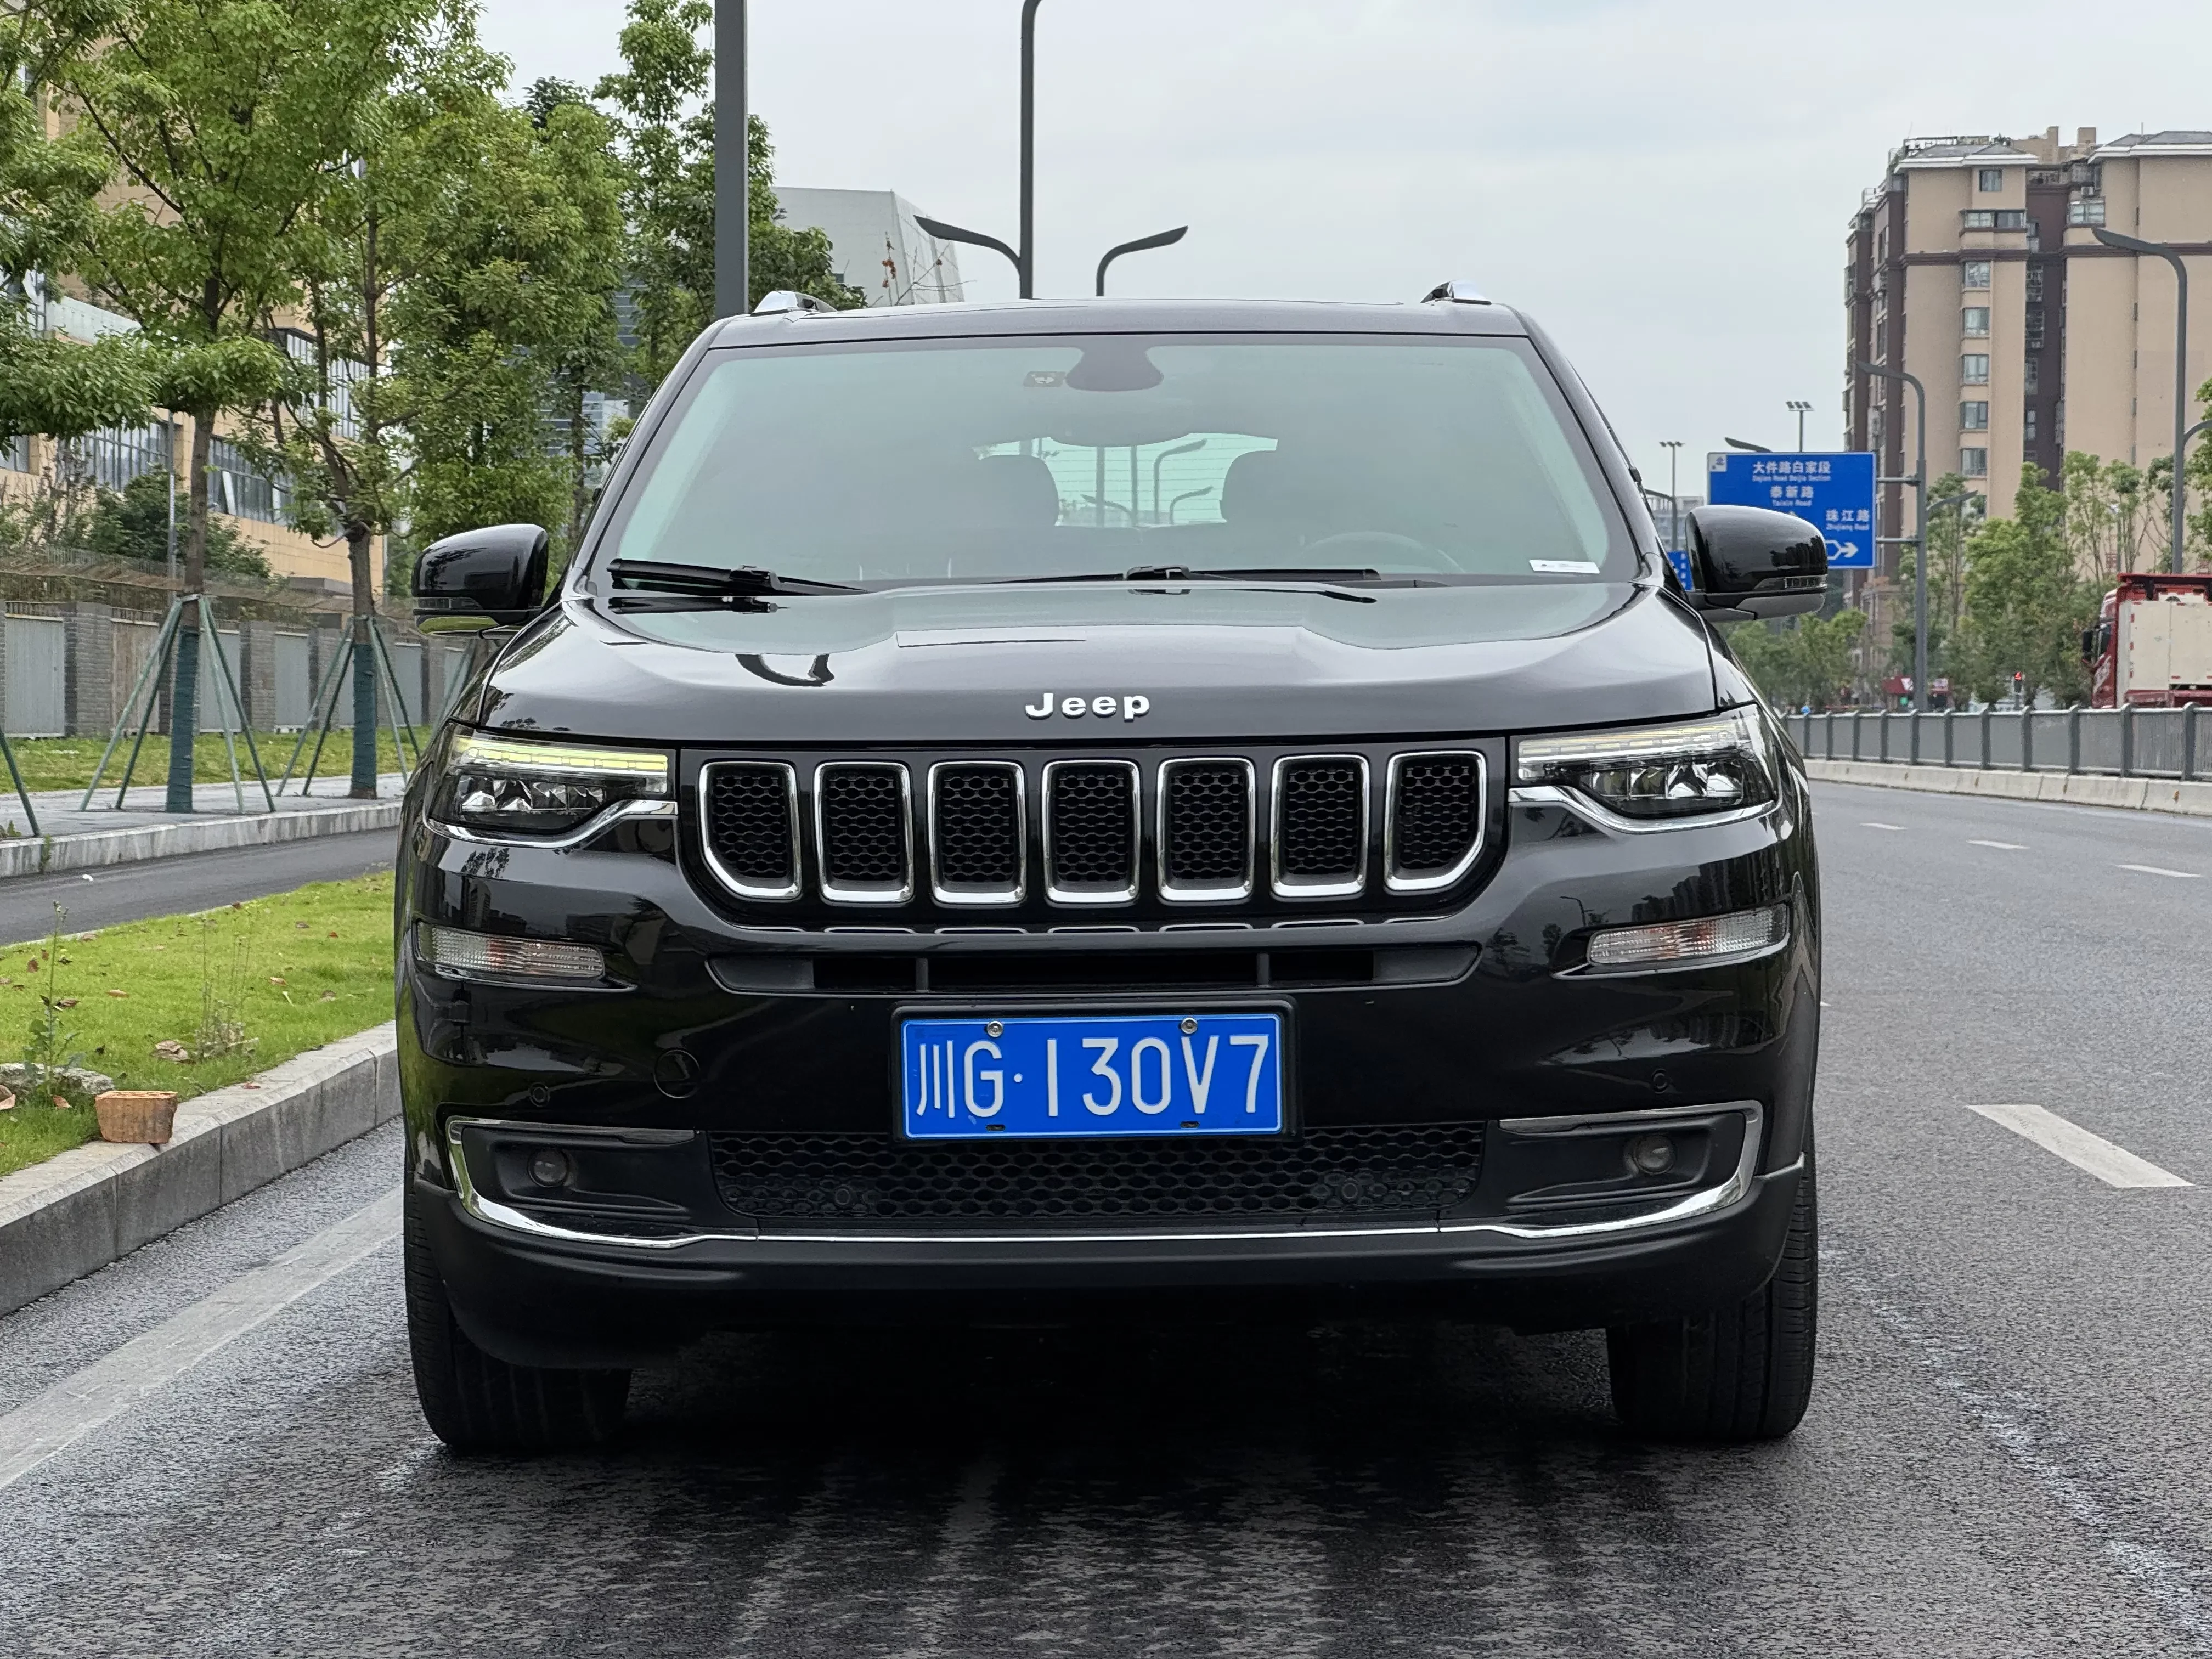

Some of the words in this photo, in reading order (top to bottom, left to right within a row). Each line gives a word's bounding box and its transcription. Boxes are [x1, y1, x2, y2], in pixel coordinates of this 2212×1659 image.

[1752, 461, 1831, 474] 大件路白家段
[1826, 509, 1869, 522] 珠江路
[1025, 692, 1150, 722] Jeep
